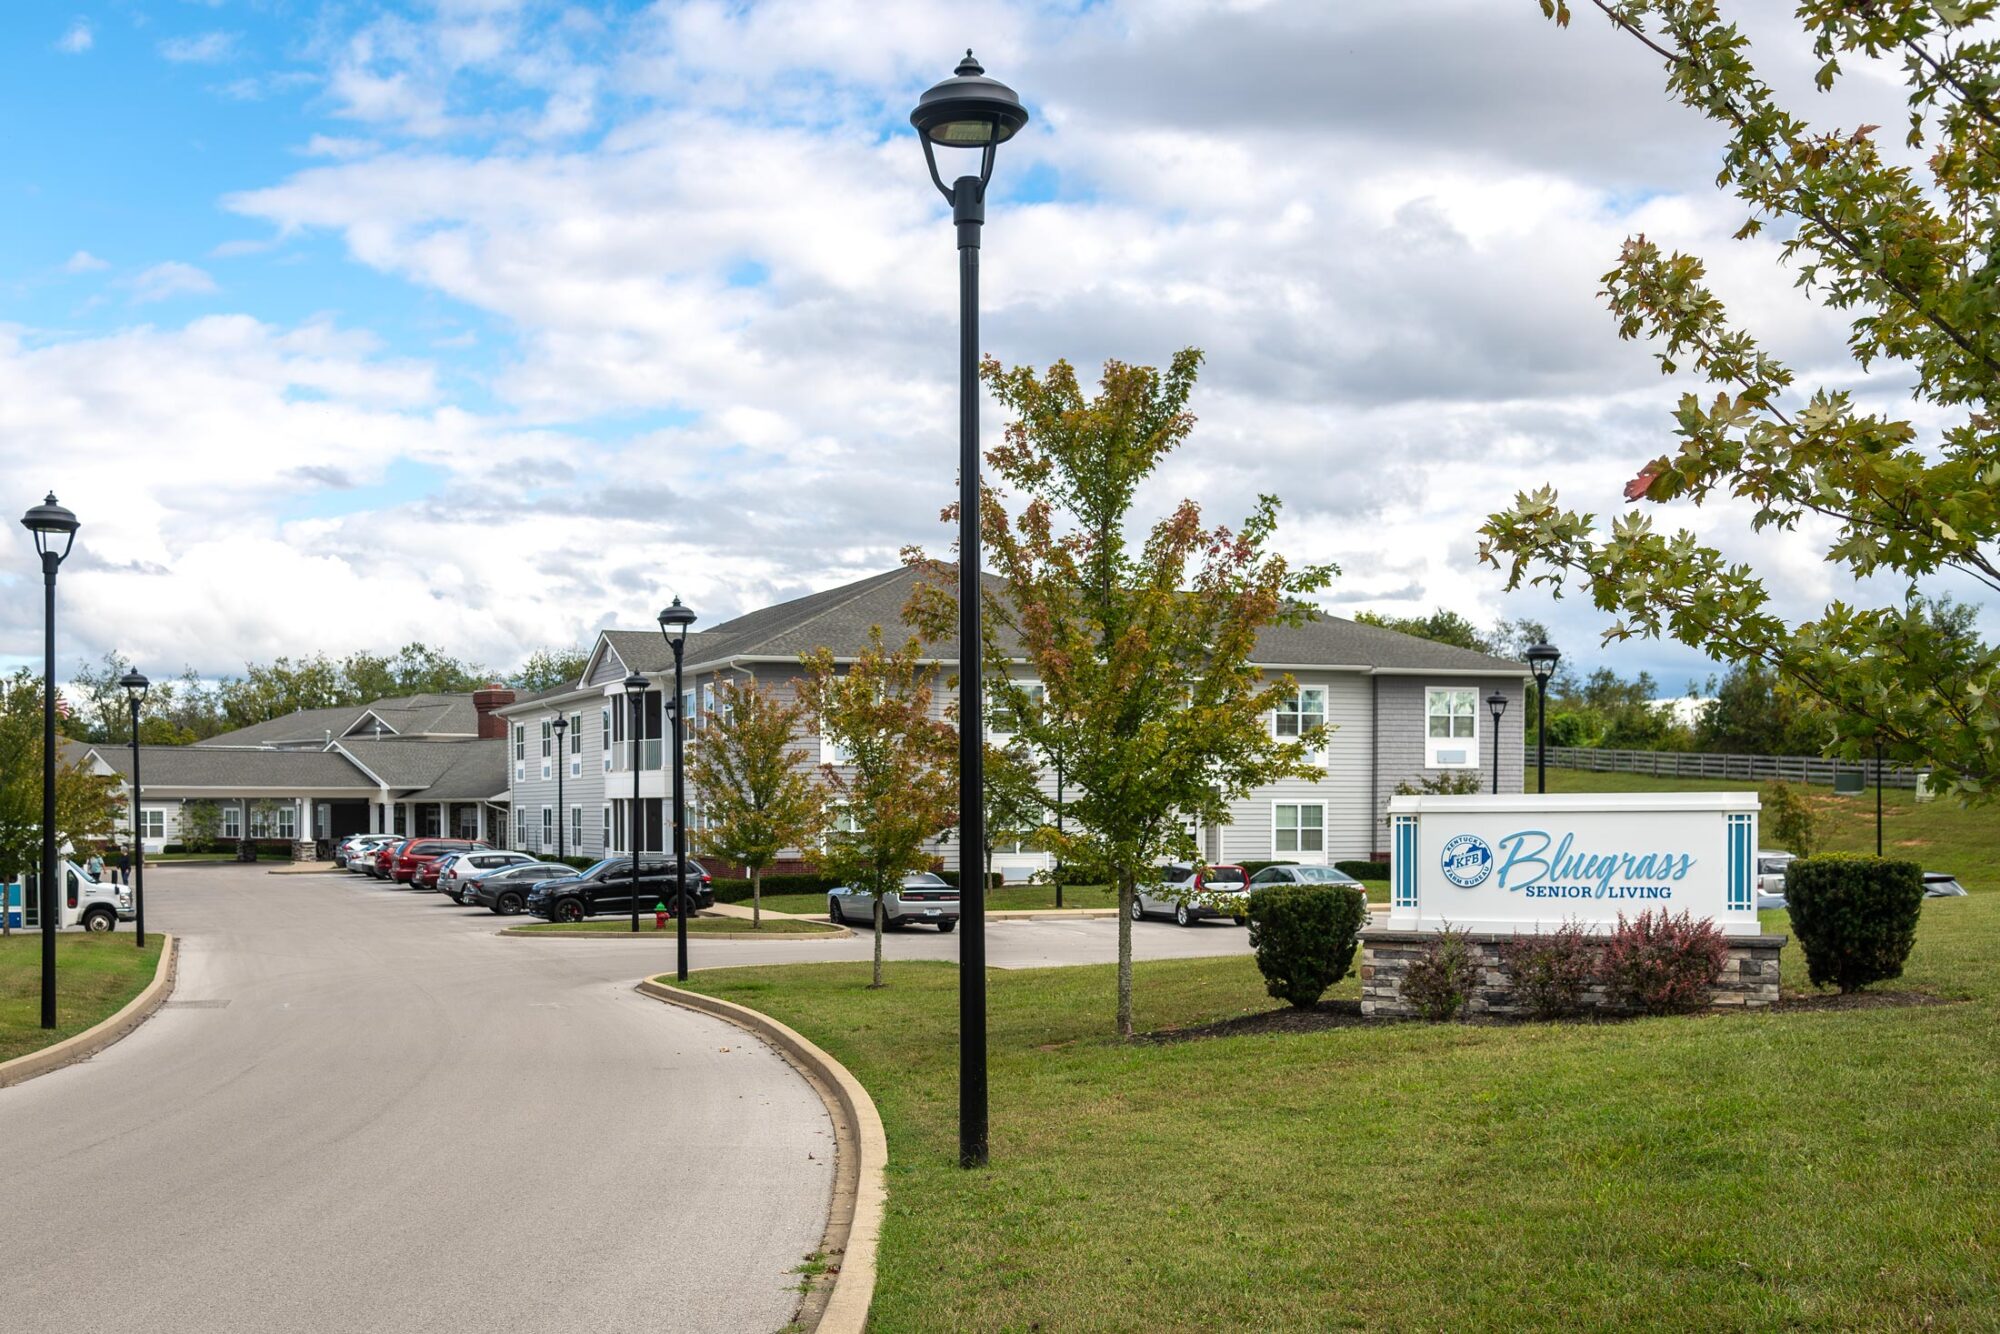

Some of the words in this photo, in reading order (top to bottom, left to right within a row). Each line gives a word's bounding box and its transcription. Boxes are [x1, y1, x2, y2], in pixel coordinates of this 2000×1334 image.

[1446, 837, 1484, 852] KENTUCKY
[1456, 853, 1479, 868] KFB
[1497, 830, 1697, 900] Bluegrass
[1446, 869, 1462, 884] FARM
[1464, 866, 1490, 885] BUREAU
[1525, 886, 1592, 898] SENIOR
[1608, 886, 1672, 899] LIVING
